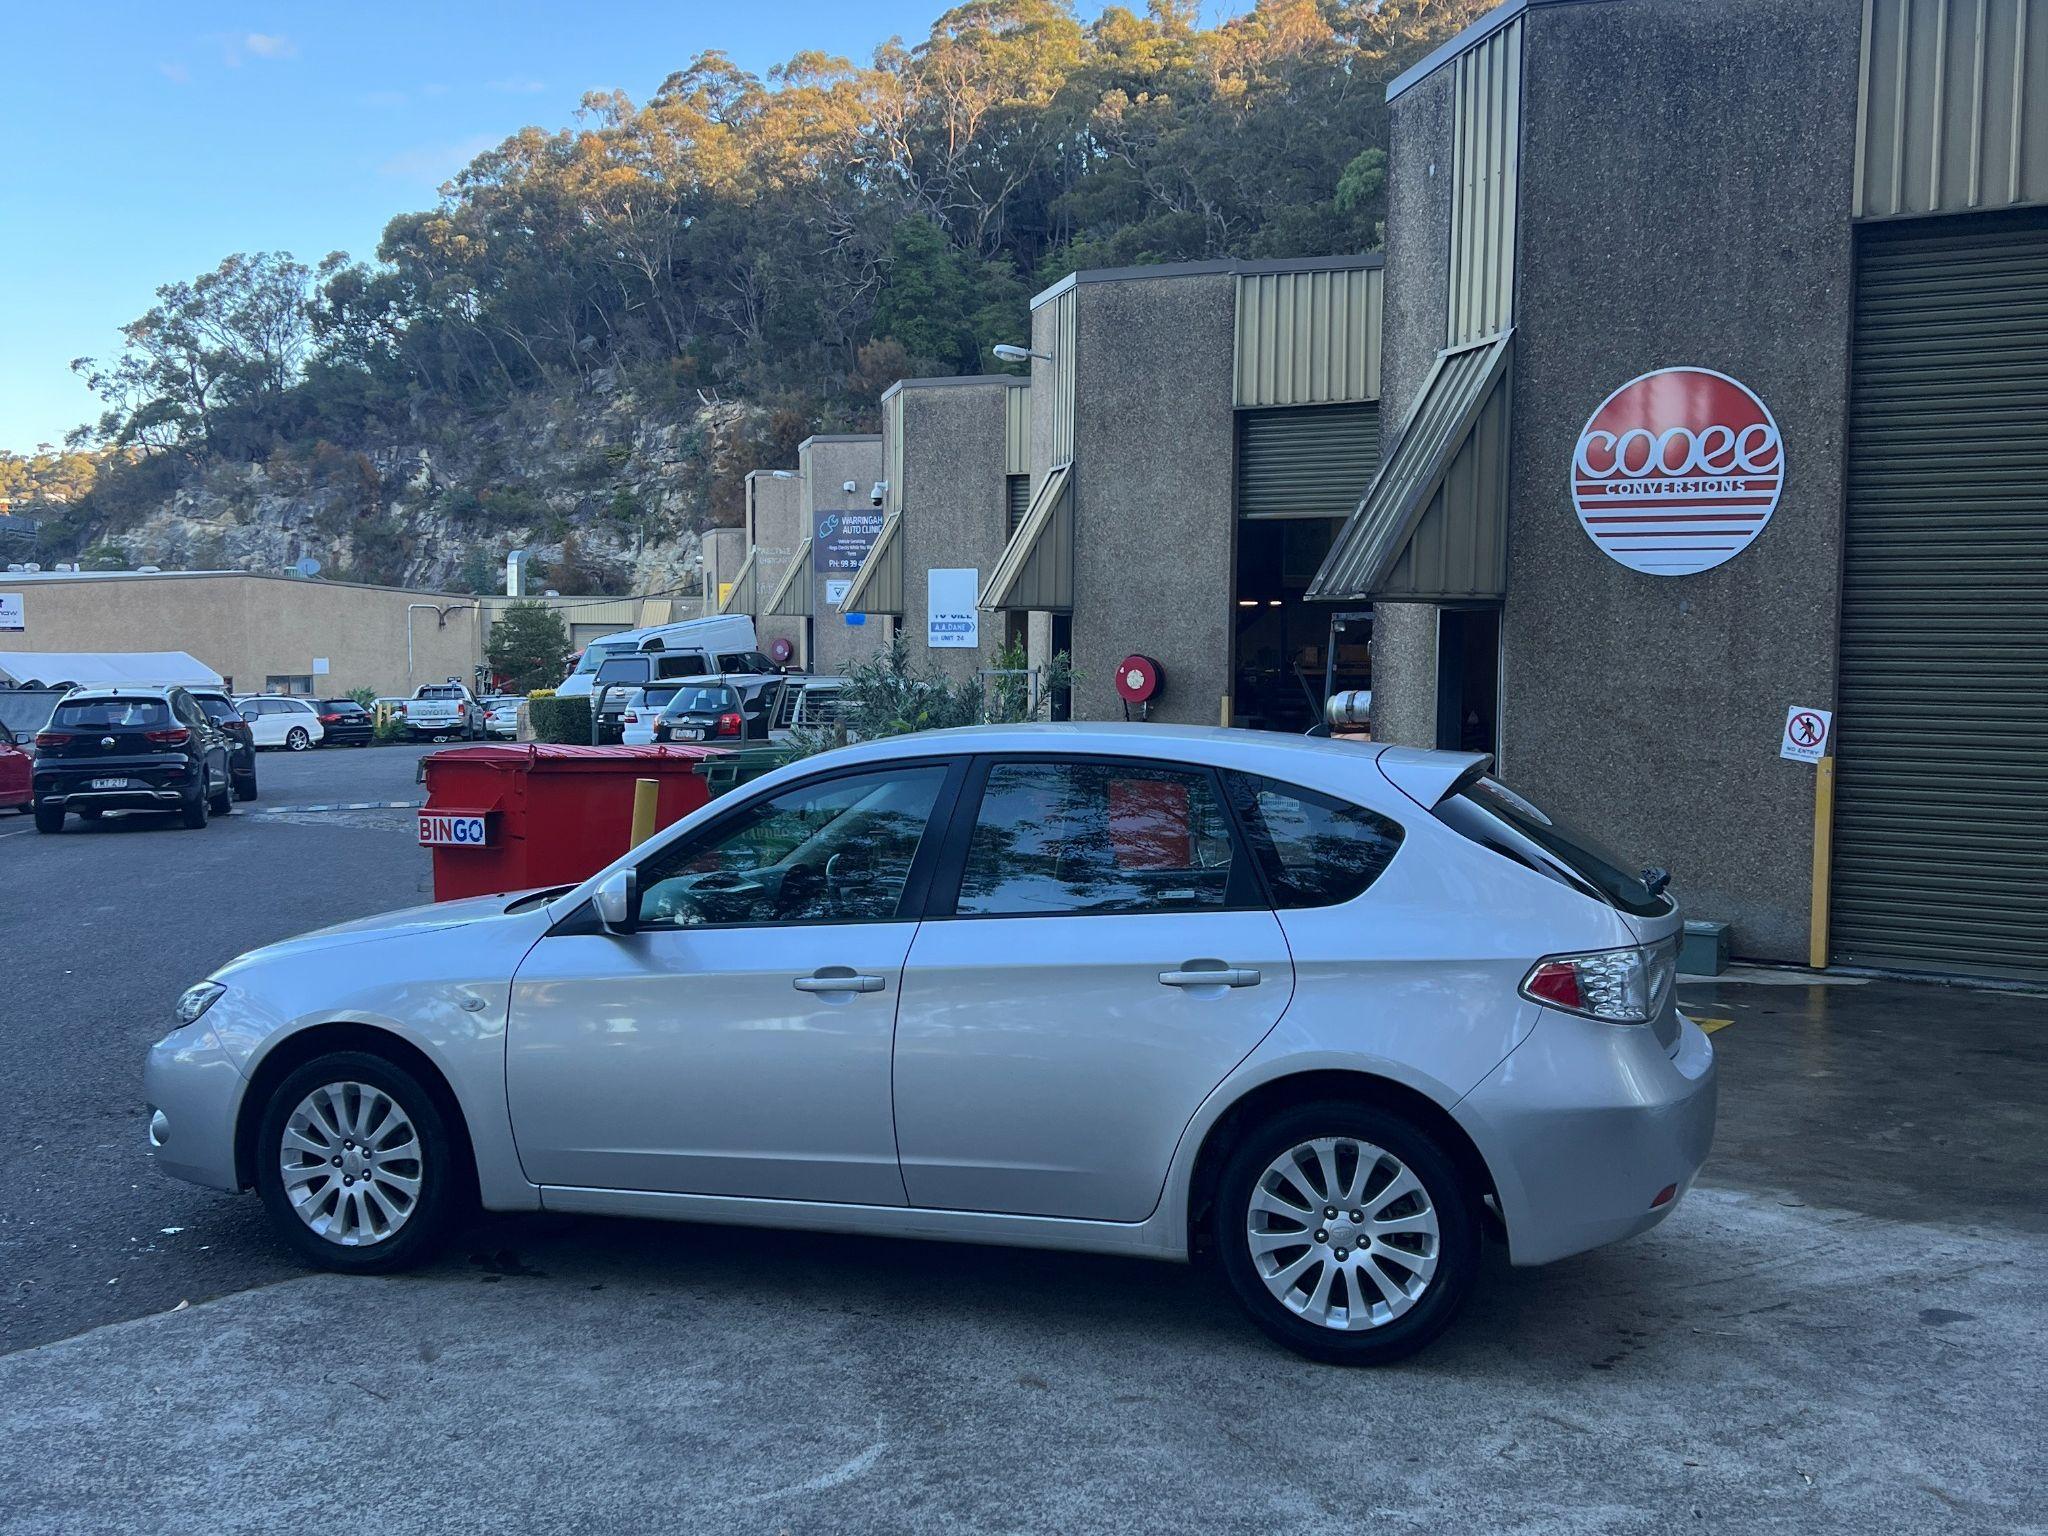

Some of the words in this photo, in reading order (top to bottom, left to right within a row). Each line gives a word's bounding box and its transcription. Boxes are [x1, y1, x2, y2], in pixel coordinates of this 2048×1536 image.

[1606, 479, 1746, 496] CONVERSIONS
[841, 516, 883, 525] WARRINGAH
[842, 525, 861, 534] AUTO
[1786, 744, 1797, 752] NO
[1797, 747, 1820, 755] ENTRY
[419, 818, 484, 843] BINGO
